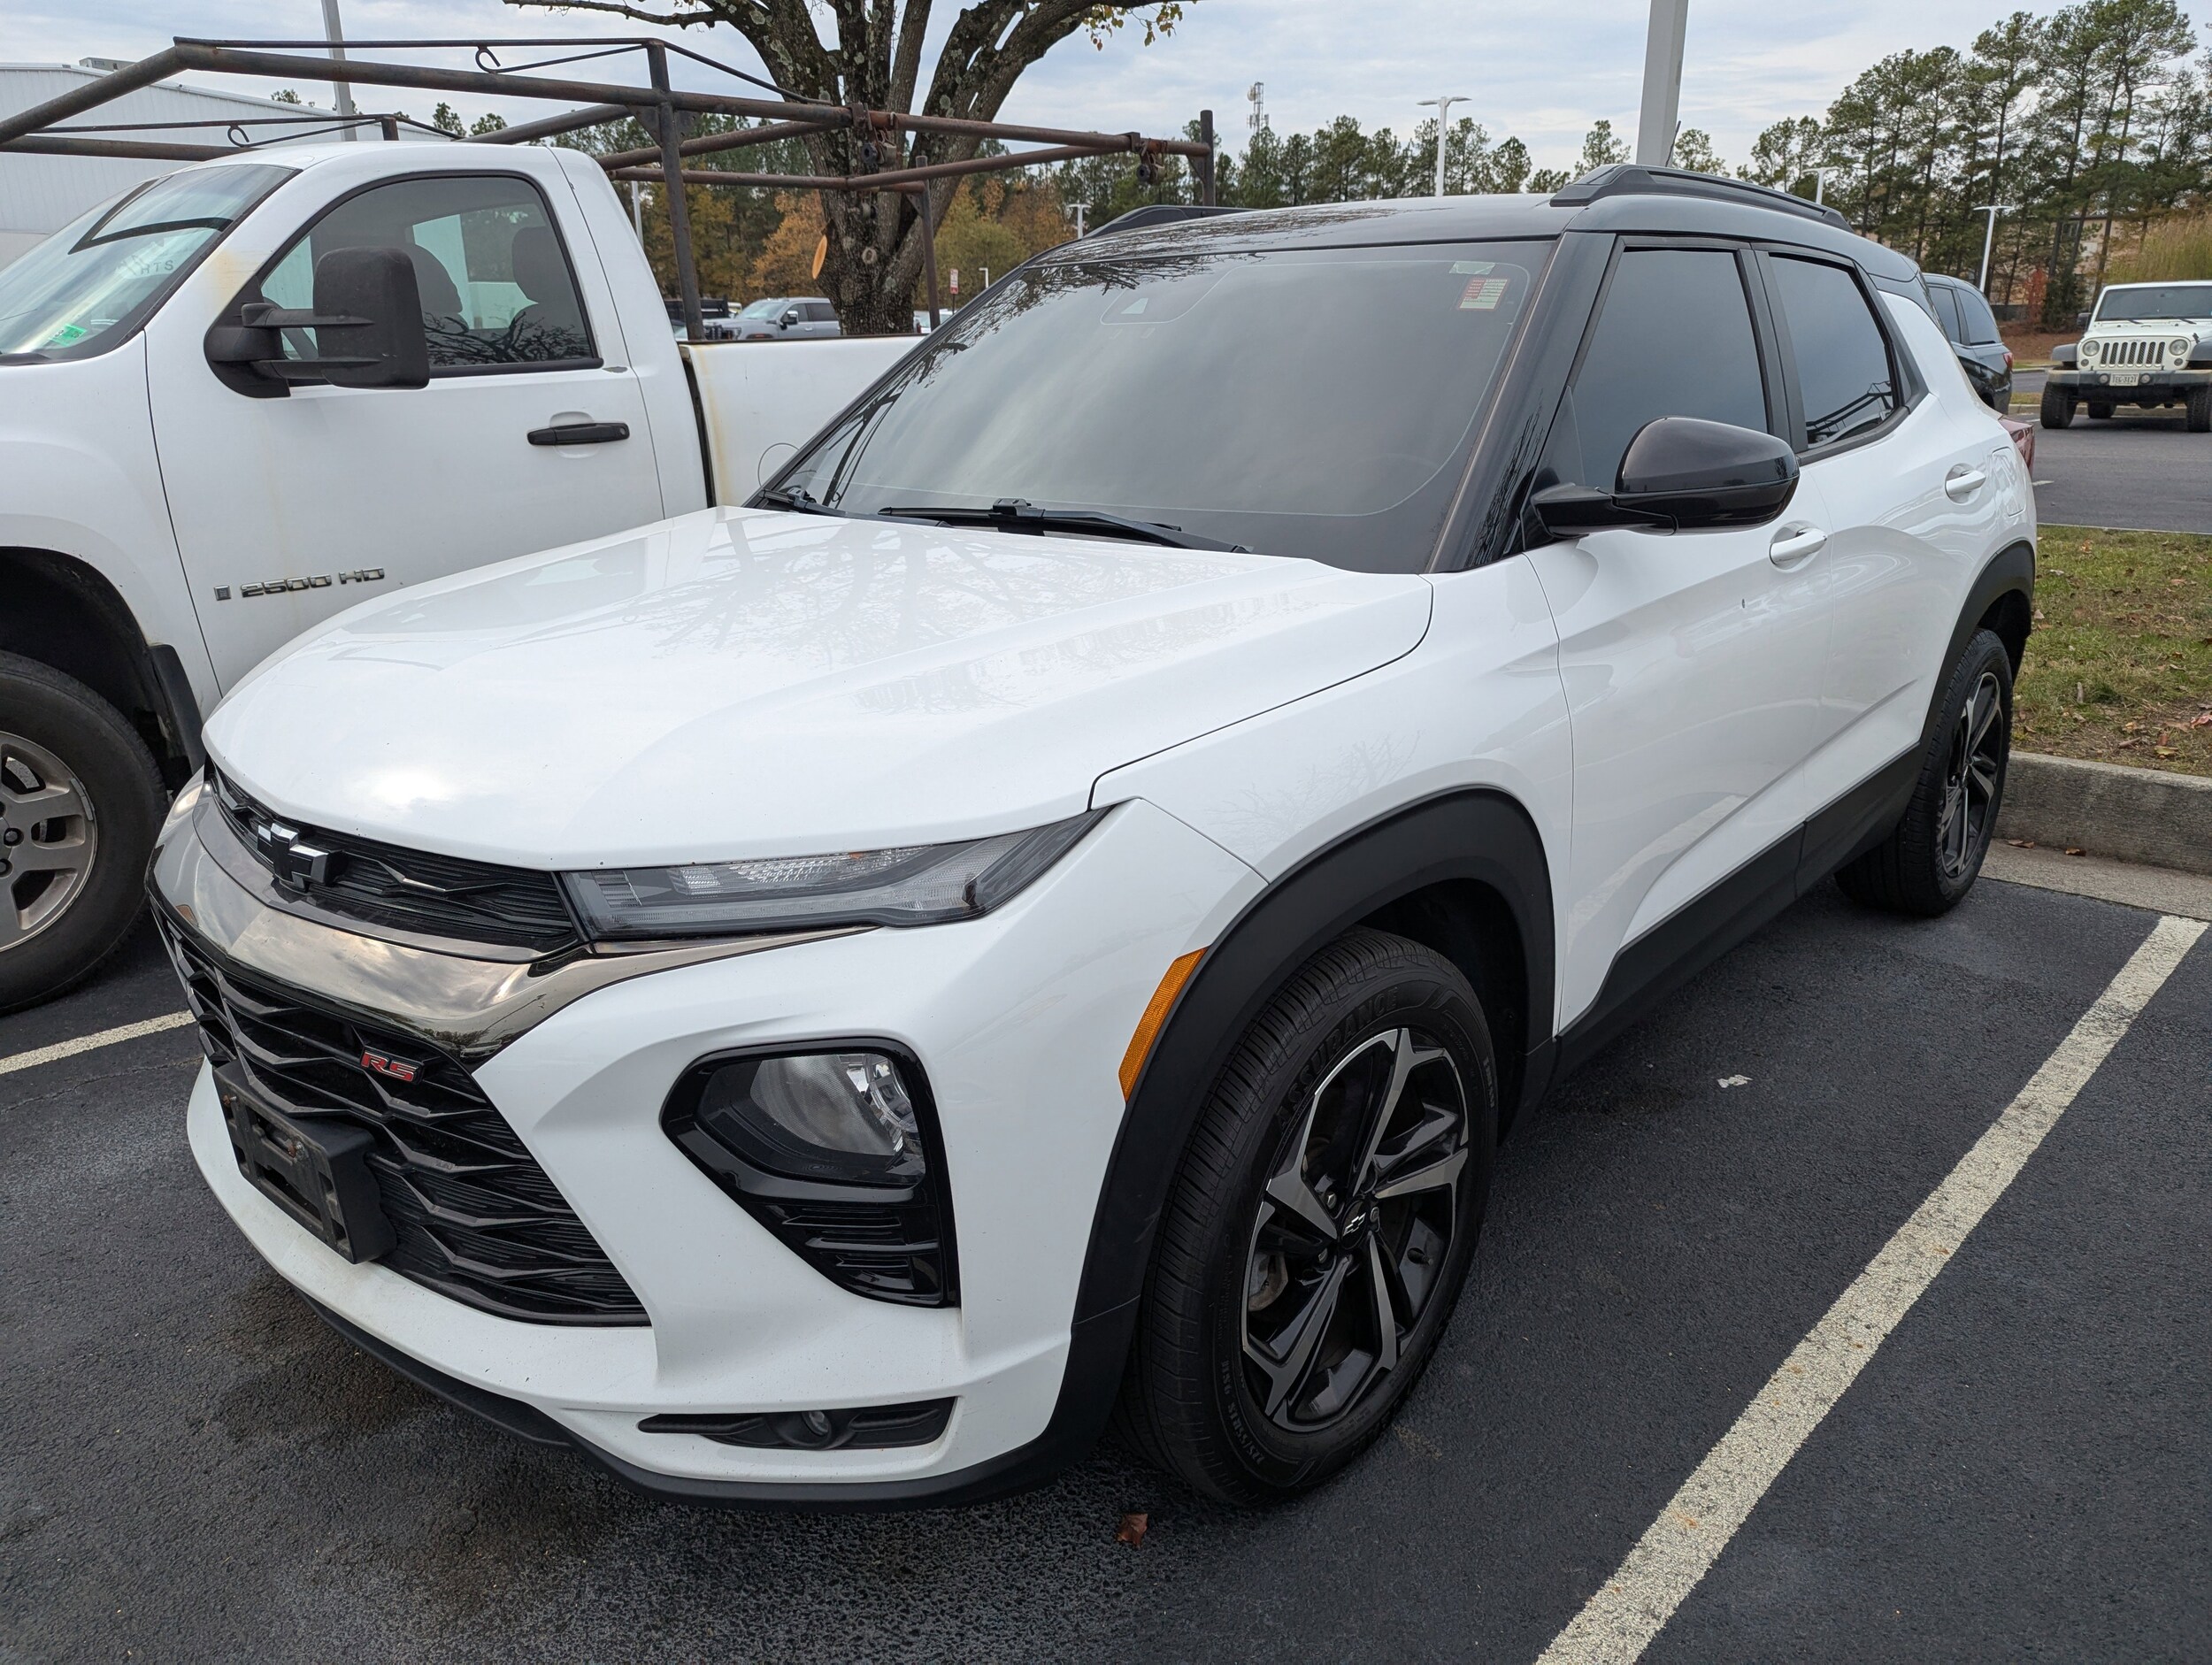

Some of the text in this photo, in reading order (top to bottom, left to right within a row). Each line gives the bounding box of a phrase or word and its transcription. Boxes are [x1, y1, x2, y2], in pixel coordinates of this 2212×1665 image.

[240, 573, 332, 598] 2500
[338, 567, 385, 584] HD
[361, 1050, 419, 1082] RS
[1276, 986, 1399, 1128] ASSURANCE
